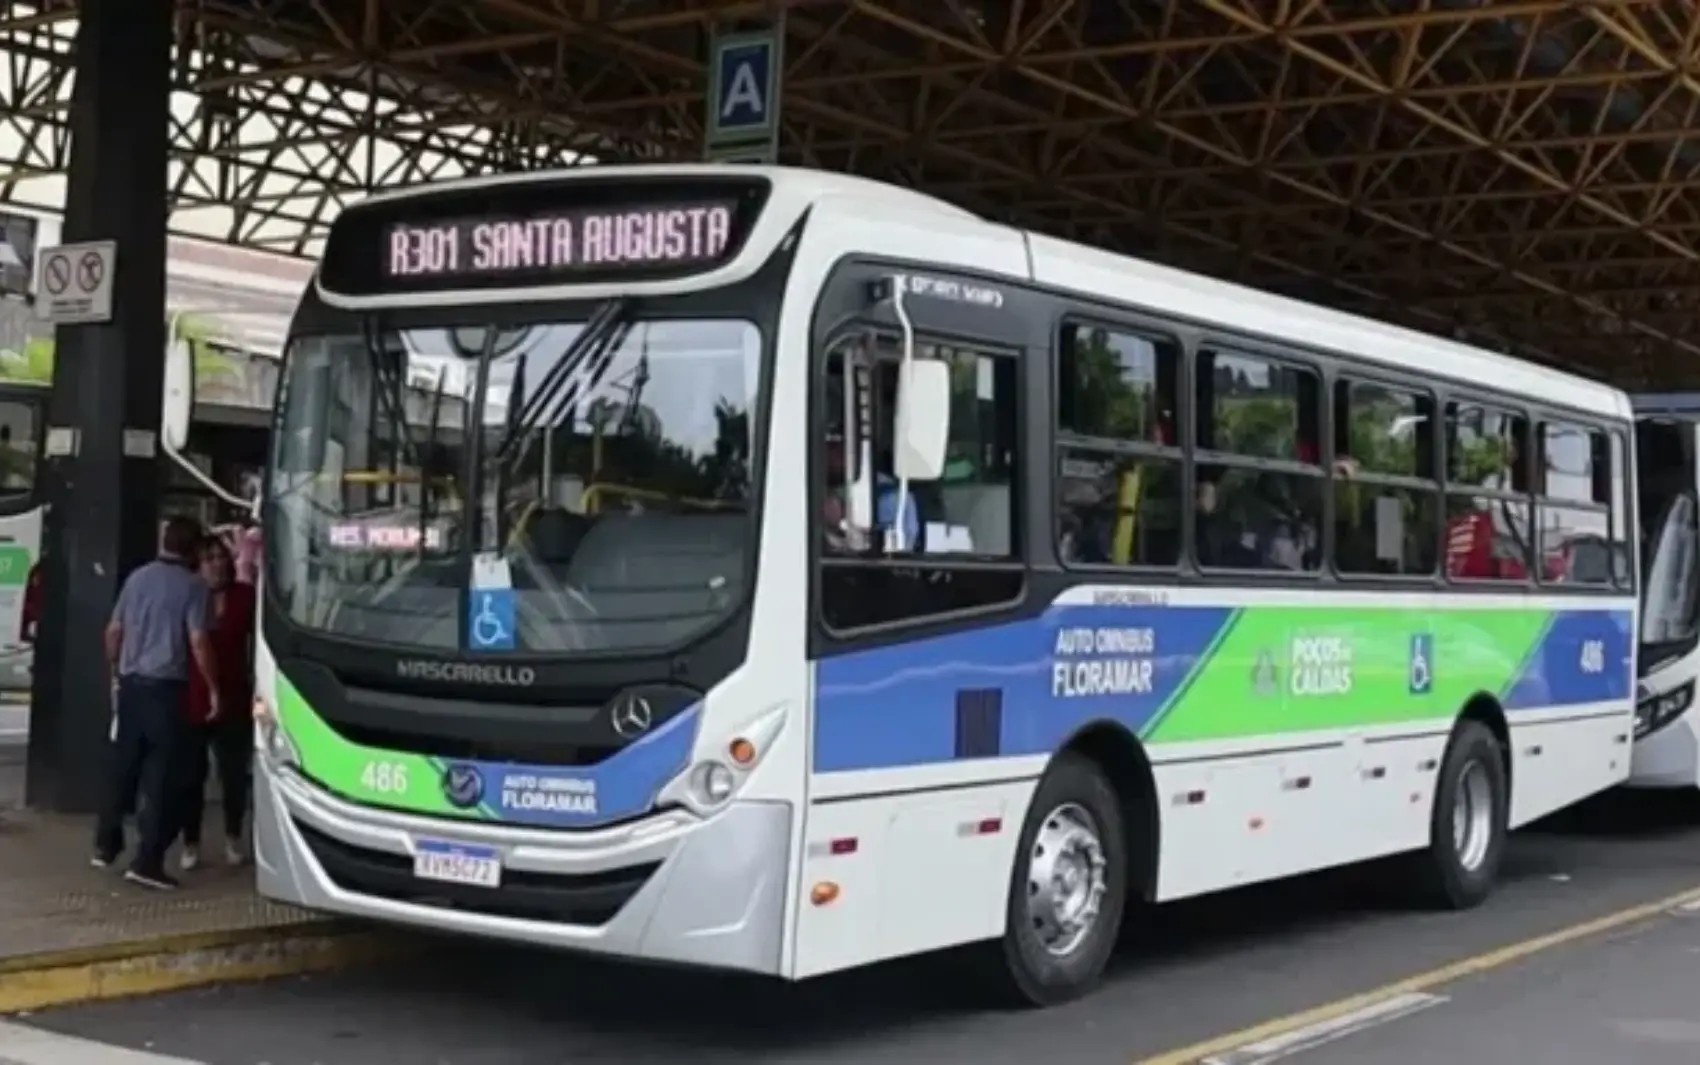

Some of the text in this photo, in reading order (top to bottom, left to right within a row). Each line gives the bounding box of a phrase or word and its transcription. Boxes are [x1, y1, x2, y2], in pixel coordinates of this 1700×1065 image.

[722, 61, 762, 117] A
[390, 207, 728, 275] R301 SANTA AUGUSTA
[1056, 627, 1155, 653] AUTO OMNIBUS
[1292, 637, 1341, 666] POÇOS
[1581, 640, 1605, 672] 486
[397, 660, 535, 686] MASCARELLO
[1053, 660, 1153, 697] FLORAMAR
[1292, 665, 1352, 695] CALDAS
[361, 761, 408, 793] 486
[503, 775, 595, 794] AUTO OMNIBUS
[502, 790, 597, 815] FLORAMAR
